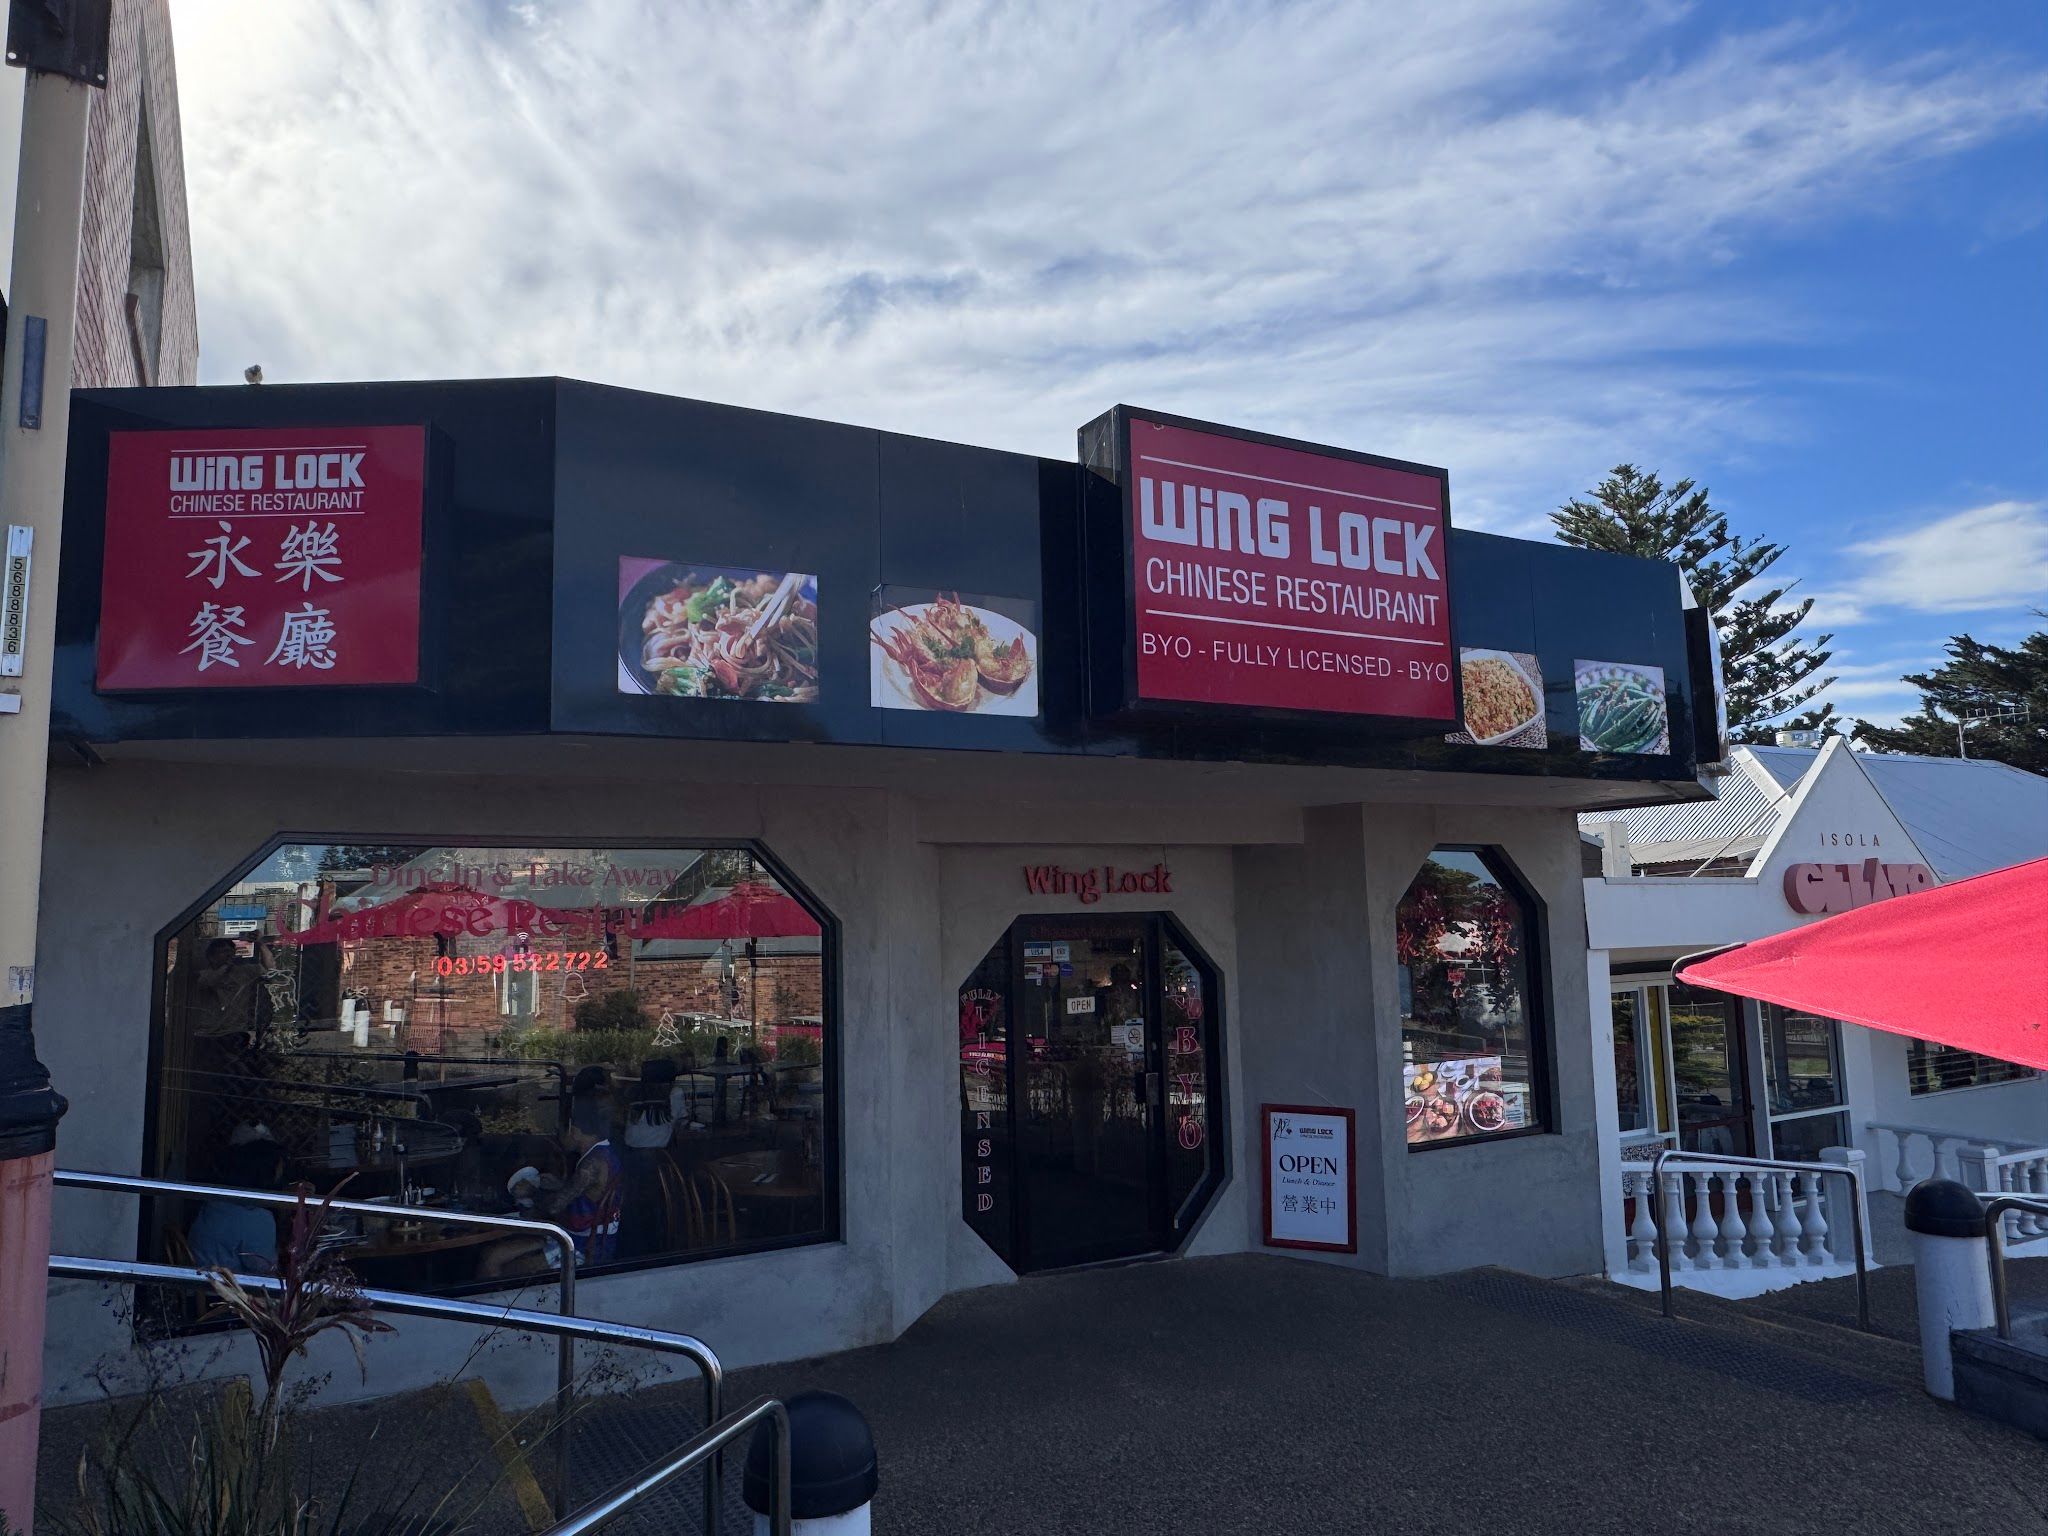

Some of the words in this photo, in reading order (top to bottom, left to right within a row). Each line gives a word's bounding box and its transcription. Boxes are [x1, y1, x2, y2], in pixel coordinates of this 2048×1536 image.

[275, 453, 366, 489] LOCK
[170, 494, 245, 513] CHINESE
[250, 491, 364, 512] RESTAURANT
[186, 520, 344, 592] 永樂
[1309, 505, 1440, 580] LOCK
[1146, 556, 1268, 607] CHINESE
[1276, 575, 1439, 626] RESTAURANT
[178, 601, 338, 672] 餐廳
[1142, 632, 1192, 658] BYO
[1213, 640, 1280, 667] FULLY
[1287, 648, 1392, 677] LICENSED
[1409, 661, 1449, 682] BYO
[1821, 832, 1880, 846] ISOLA
[372, 863, 443, 887] Dine
[491, 862, 512, 886] &
[528, 861, 593, 886] Take
[603, 863, 677, 887] Away
[1024, 864, 1100, 904] Wing
[1105, 863, 1173, 893] Lock
[1071, 1000, 1091, 1011] OPEN
[1279, 1154, 1337, 1175] OPEN
